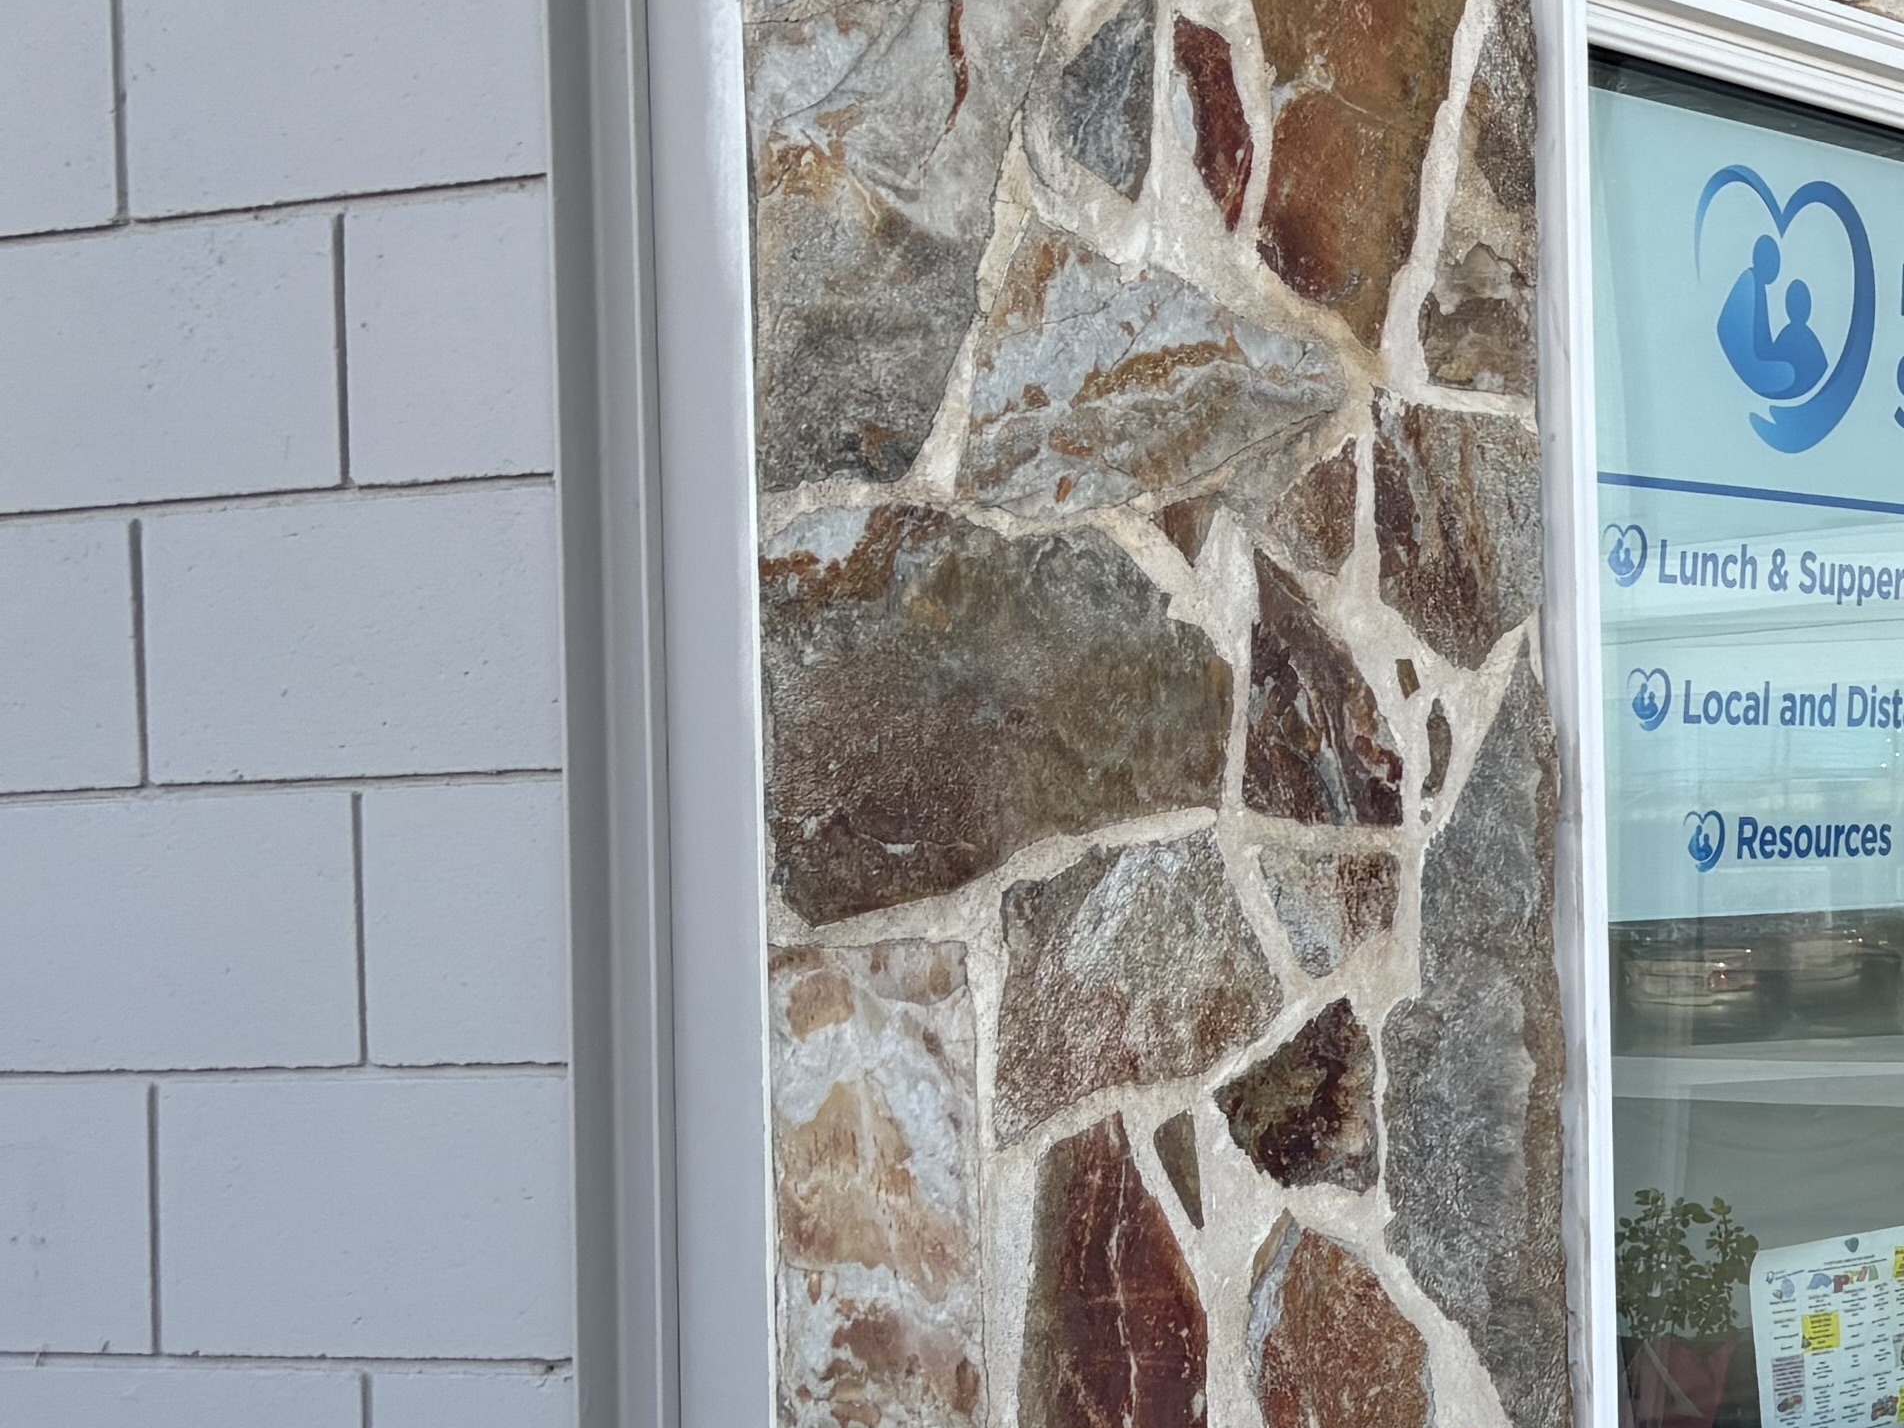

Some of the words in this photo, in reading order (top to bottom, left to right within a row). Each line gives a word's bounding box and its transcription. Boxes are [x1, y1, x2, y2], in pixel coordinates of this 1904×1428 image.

[1658, 538, 1758, 590] Lunch
[1768, 548, 1789, 593] &
[1683, 679, 1771, 727] Local
[1779, 683, 1838, 728] and
[1737, 816, 1893, 860] Resources
